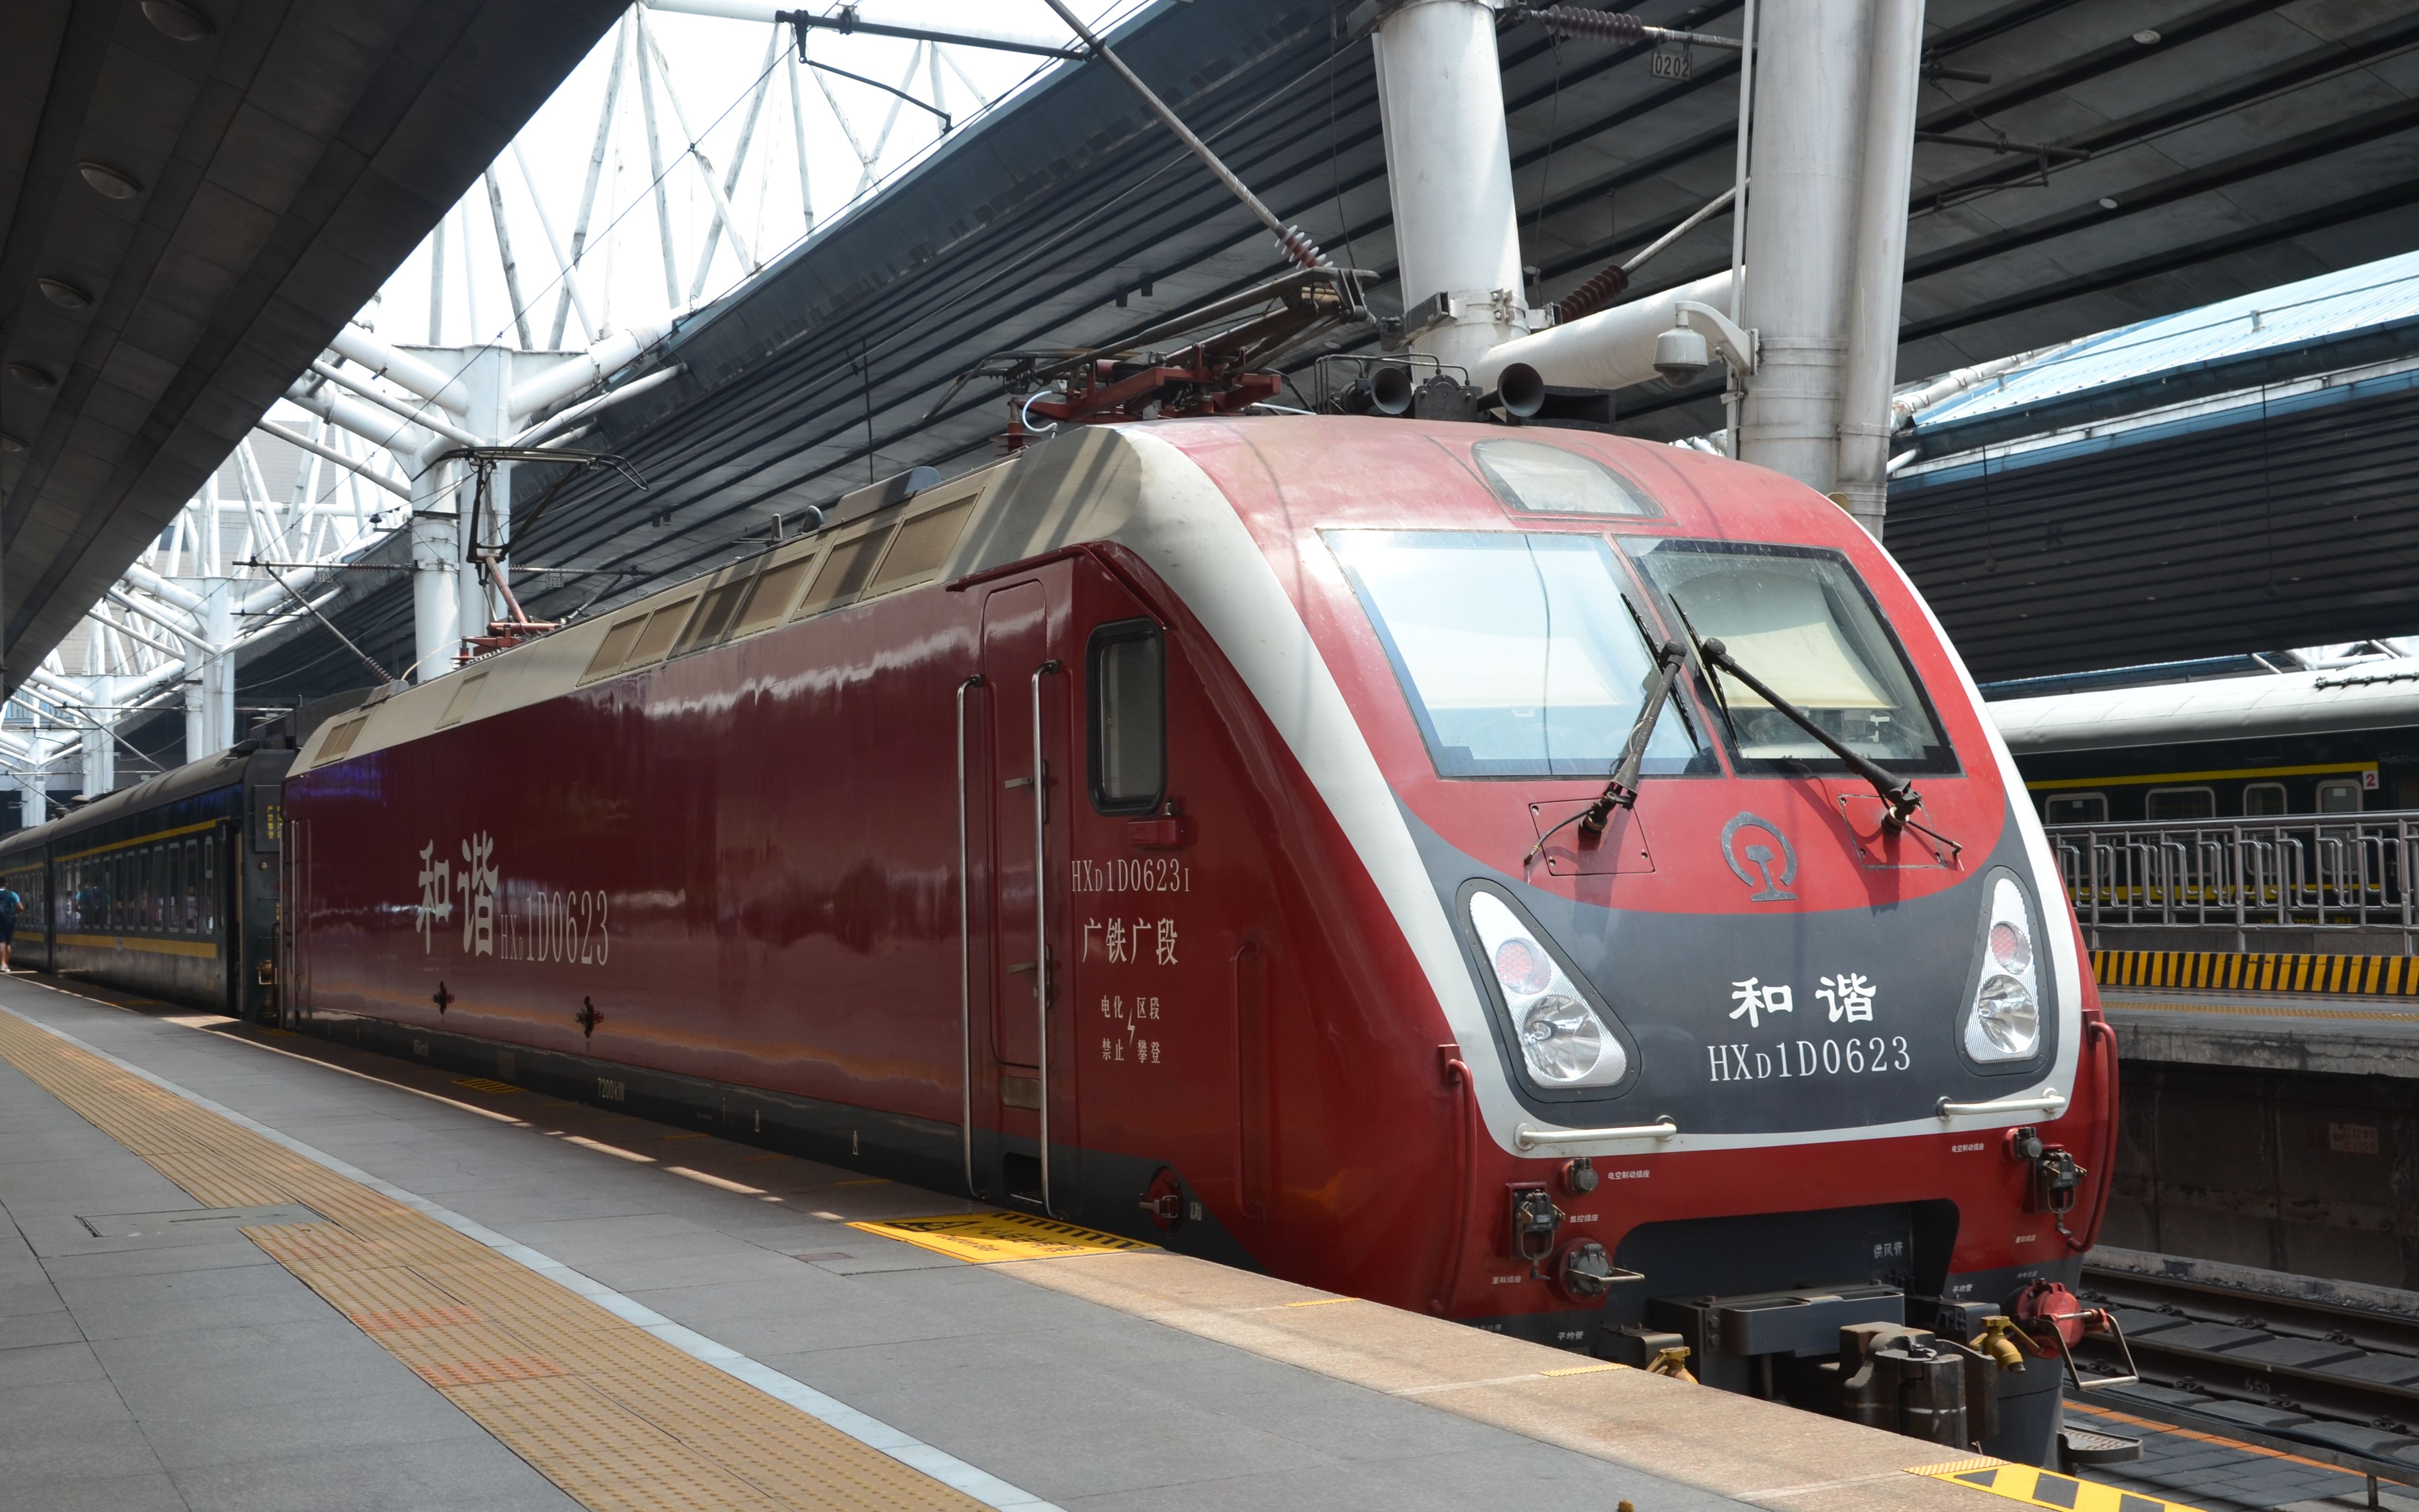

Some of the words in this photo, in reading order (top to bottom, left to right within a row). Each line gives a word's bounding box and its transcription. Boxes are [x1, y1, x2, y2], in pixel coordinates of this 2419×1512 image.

[1655, 55, 1689, 77] 0202
[2366, 773, 2375, 787] 2
[416, 830, 499, 957] 和谐
[1082, 917, 1178, 965] 广铁广段
[1101, 995, 1123, 1018] 电化
[1137, 997, 1160, 1020] 区段
[1728, 973, 1876, 1028] 和谐
[1102, 1038, 1124, 1061] 禁止
[1137, 1040, 1161, 1064] 攀登
[1707, 1036, 1911, 1082] HXD1D0623
[597, 1077, 625, 1102] 7200kW
[1952, 1143, 1985, 1153] 电空制动插座
[1607, 1170, 1650, 1180] 电空制动插座
[1570, 1214, 1599, 1223] 集控插座
[1873, 1241, 1903, 1258] 供风管
[1492, 1275, 1522, 1285] 重联插座
[1952, 1283, 1973, 1293] 平均管
[1557, 1331, 1584, 1341] 平均管
